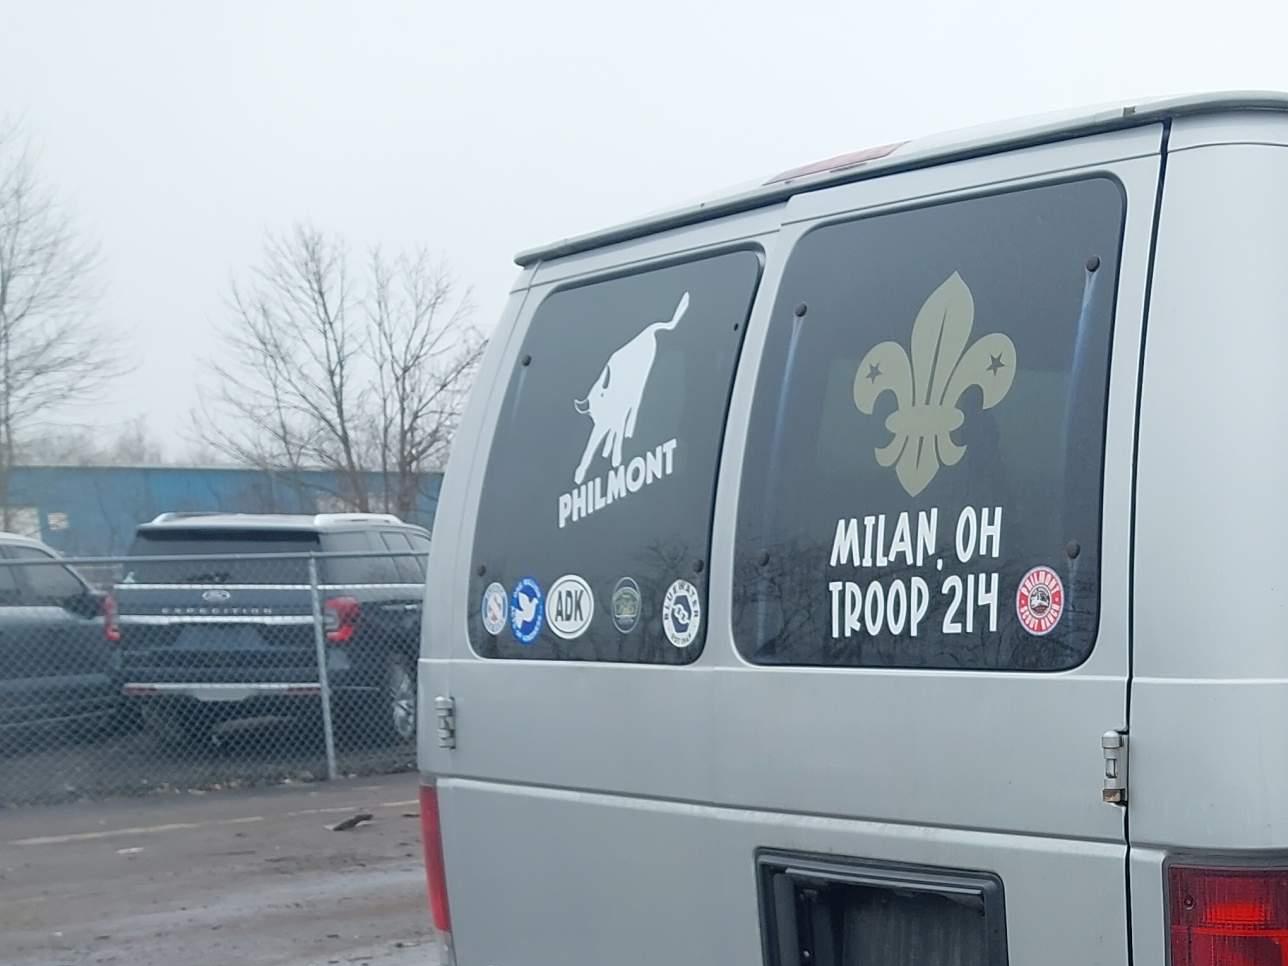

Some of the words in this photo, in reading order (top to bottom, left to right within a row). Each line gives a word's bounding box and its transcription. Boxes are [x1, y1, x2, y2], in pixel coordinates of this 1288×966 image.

[558, 438, 678, 528] PHILMONT
[829, 507, 943, 571] MILAN,
[955, 505, 1003, 563] OH
[555, 589, 584, 622] ADK
[828, 576, 930, 638] TROOP
[941, 573, 999, 633] 214
